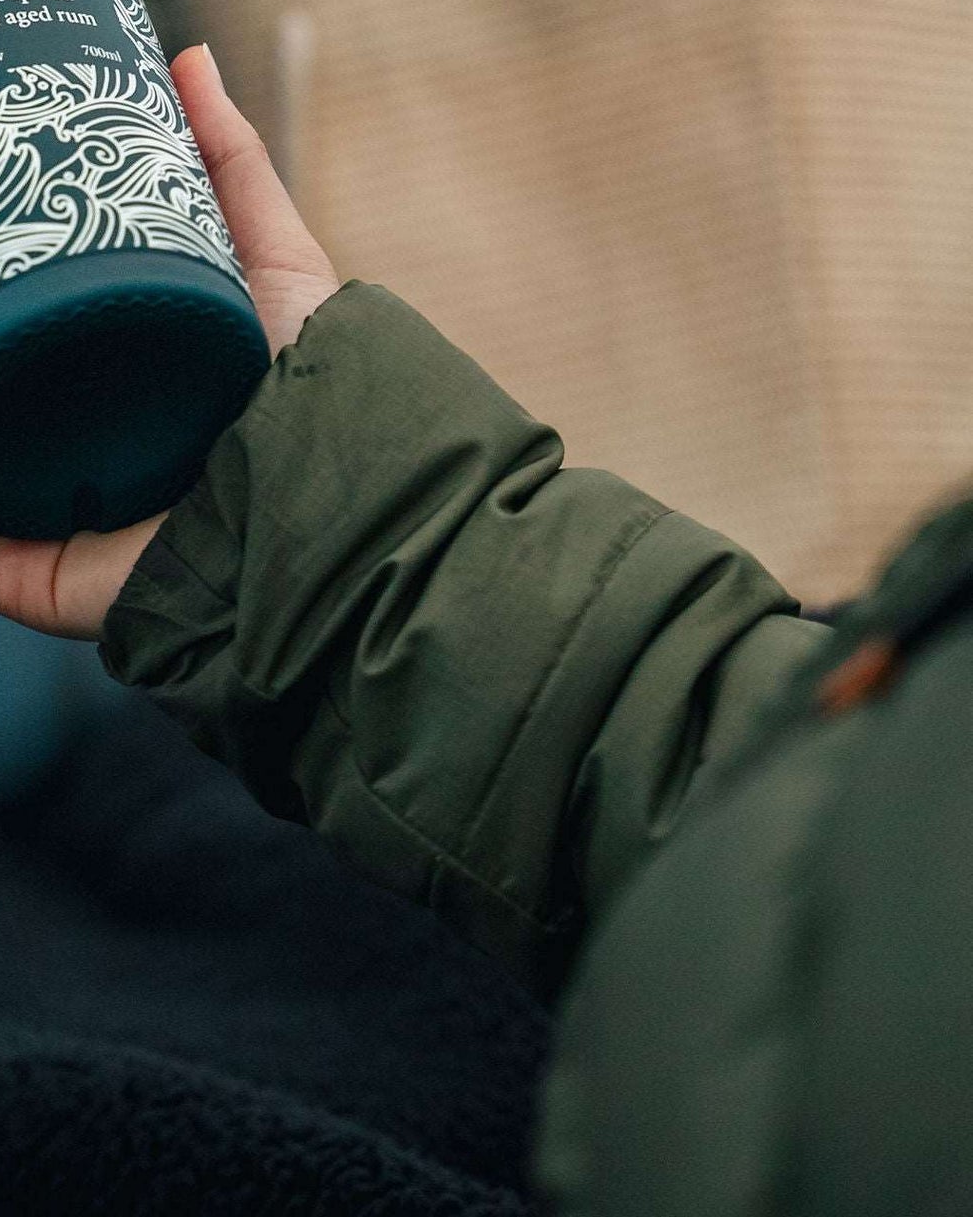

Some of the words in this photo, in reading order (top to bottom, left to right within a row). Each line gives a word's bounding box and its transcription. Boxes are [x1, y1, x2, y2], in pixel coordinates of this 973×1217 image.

[4, 6, 53, 28] aged
[55, 9, 98, 27] rum
[80, 44, 123, 63] 700ml
